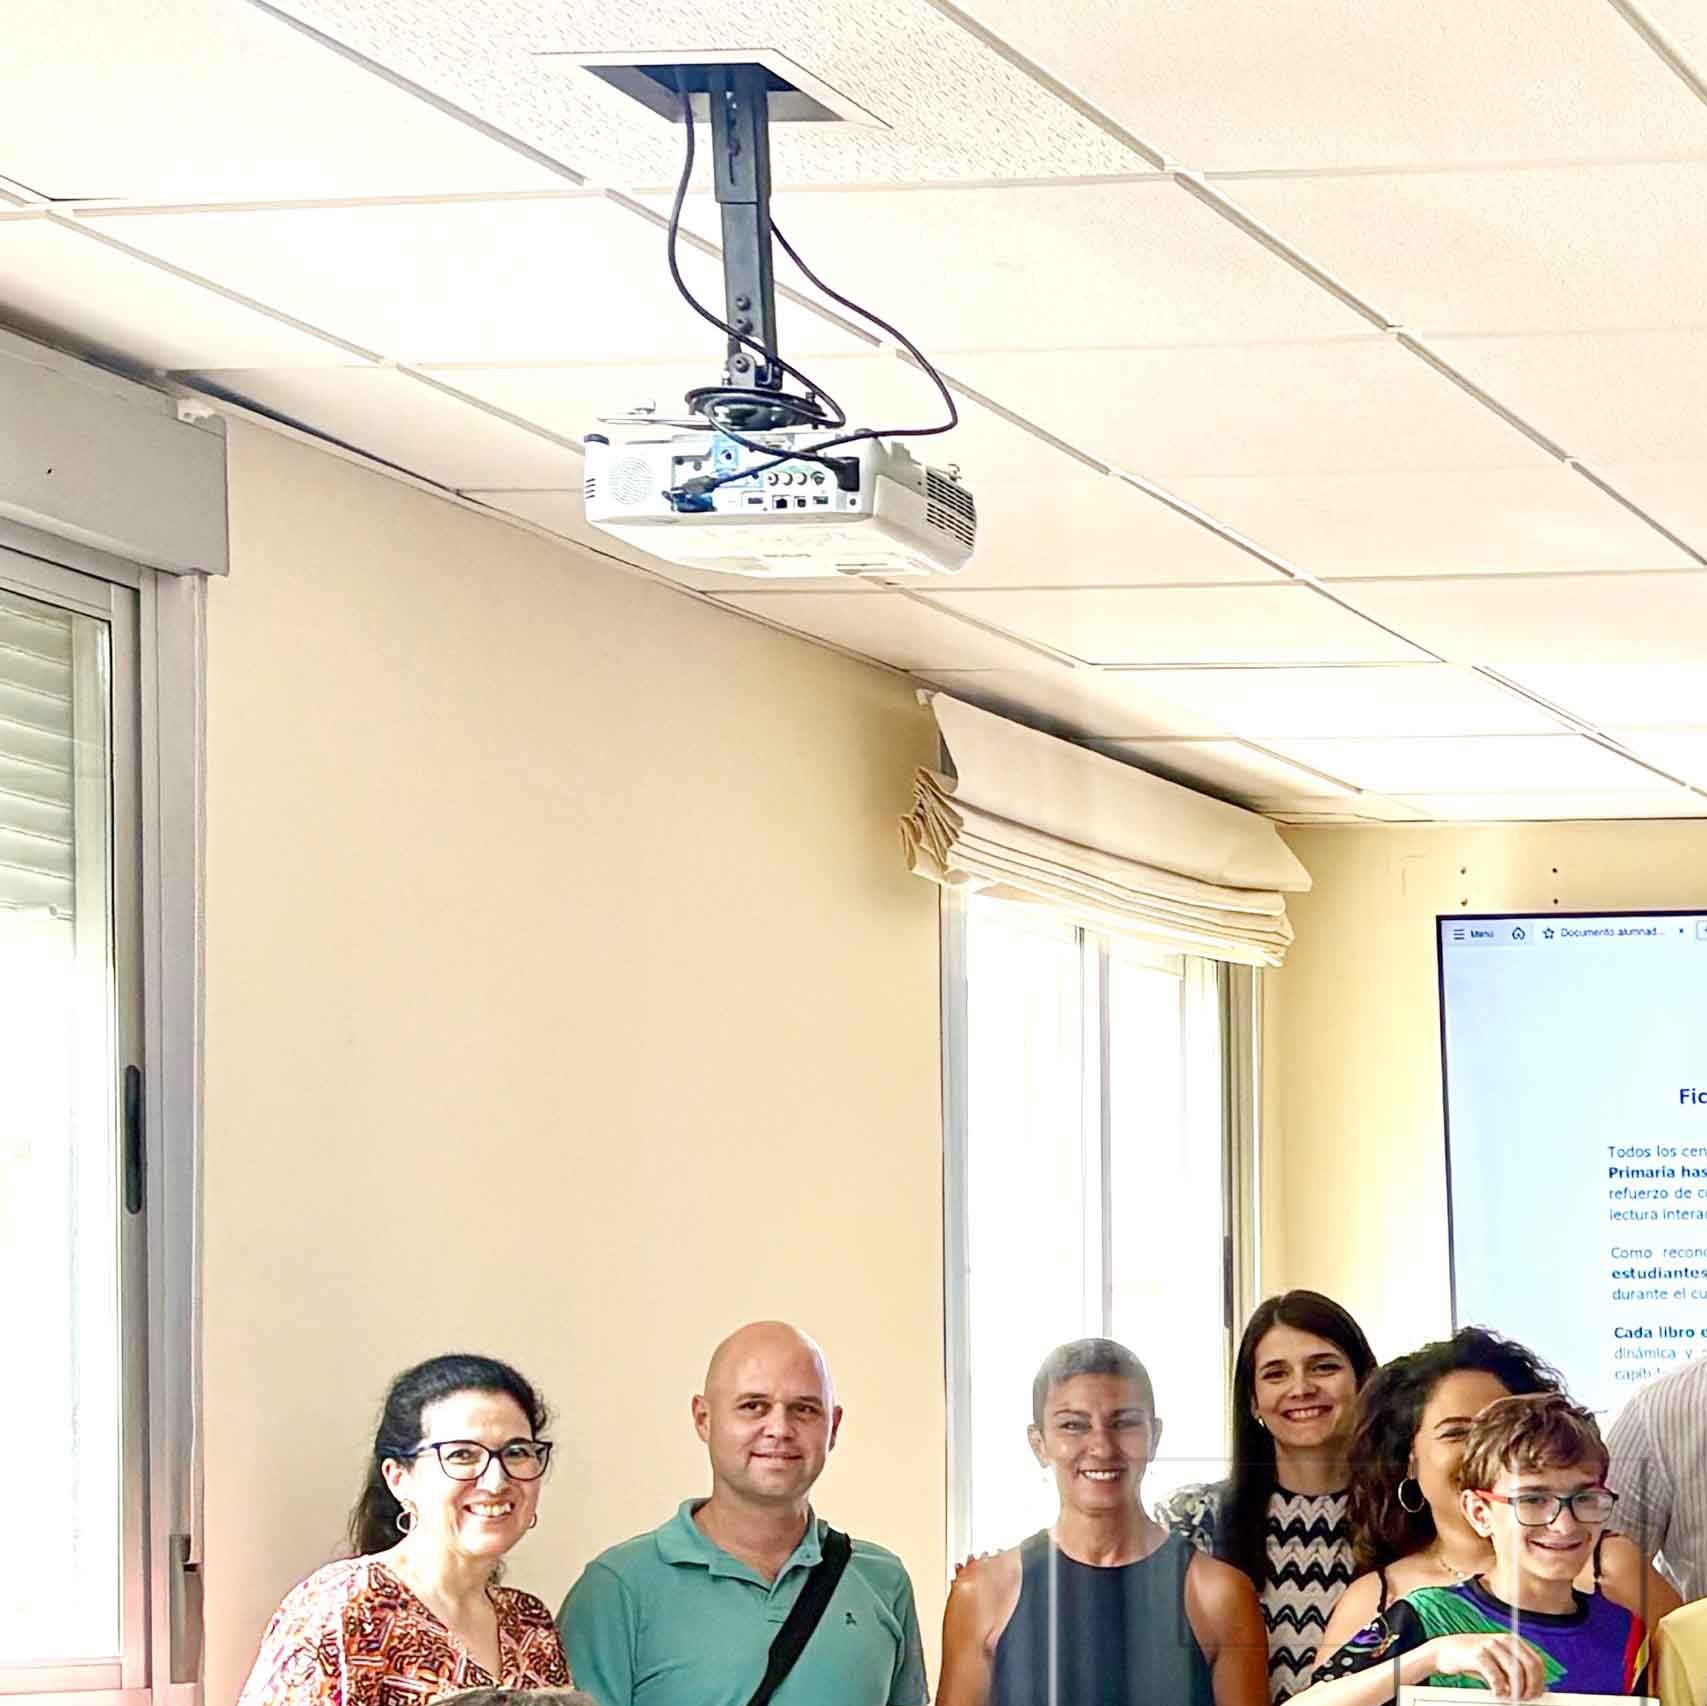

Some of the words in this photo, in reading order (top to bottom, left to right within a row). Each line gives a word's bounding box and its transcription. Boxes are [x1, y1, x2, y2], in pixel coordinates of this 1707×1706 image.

[1560, 927, 1615, 939] Documento
[1608, 1144, 1651, 1158] Todos
[1656, 1143, 1677, 1157] los
[1608, 1164, 1675, 1178] Primaria
[1612, 1265, 1707, 1279] estudiantes
[1614, 1324, 1652, 1338] Cada
[1658, 1324, 1695, 1338] libro
